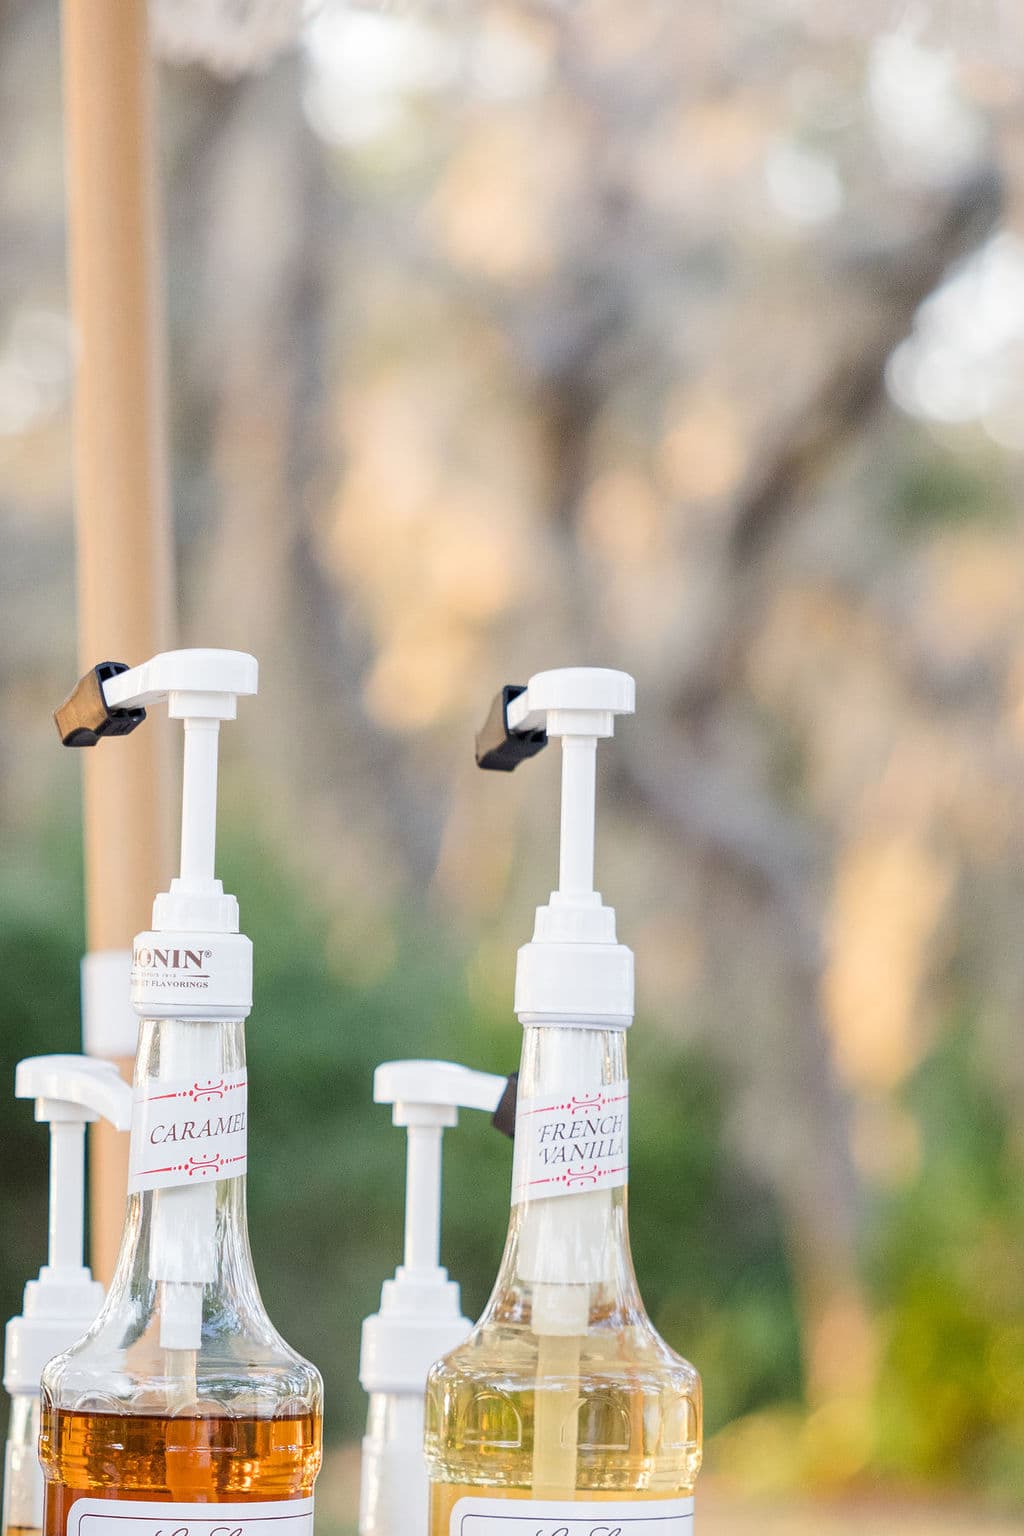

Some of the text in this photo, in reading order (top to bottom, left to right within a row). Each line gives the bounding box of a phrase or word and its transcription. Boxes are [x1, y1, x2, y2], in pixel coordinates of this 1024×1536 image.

[151, 981, 209, 989] FLAVORINGS
[150, 1112, 246, 1145] CARAMEL
[538, 1114, 624, 1144] FRENCH
